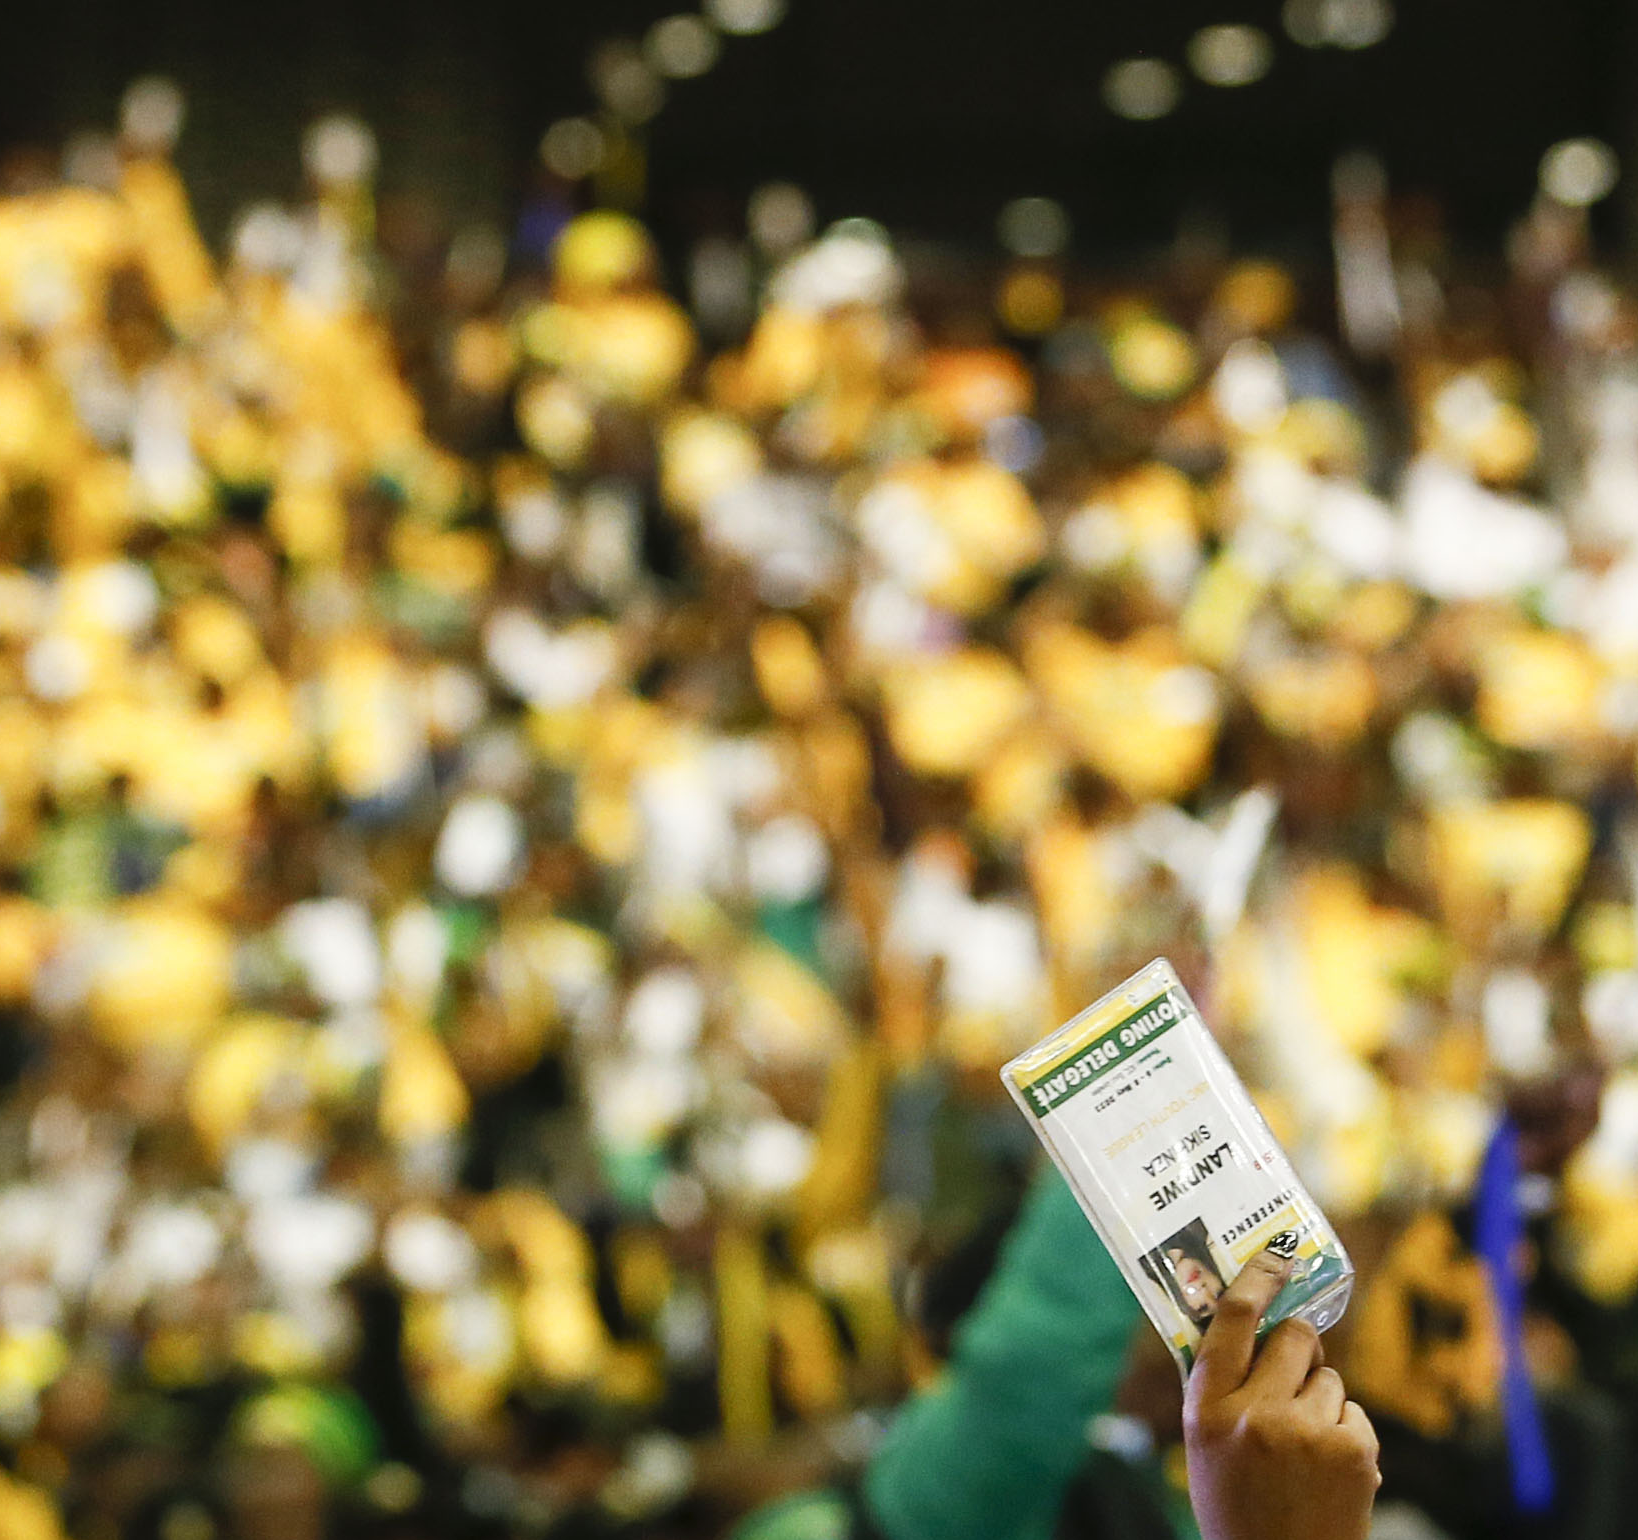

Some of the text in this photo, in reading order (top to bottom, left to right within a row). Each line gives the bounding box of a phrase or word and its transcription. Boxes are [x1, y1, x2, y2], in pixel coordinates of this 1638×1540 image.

[1031, 993, 1185, 1107] VOTING DELEGATE
[1219, 1186, 1297, 1245] ONFERENCE
